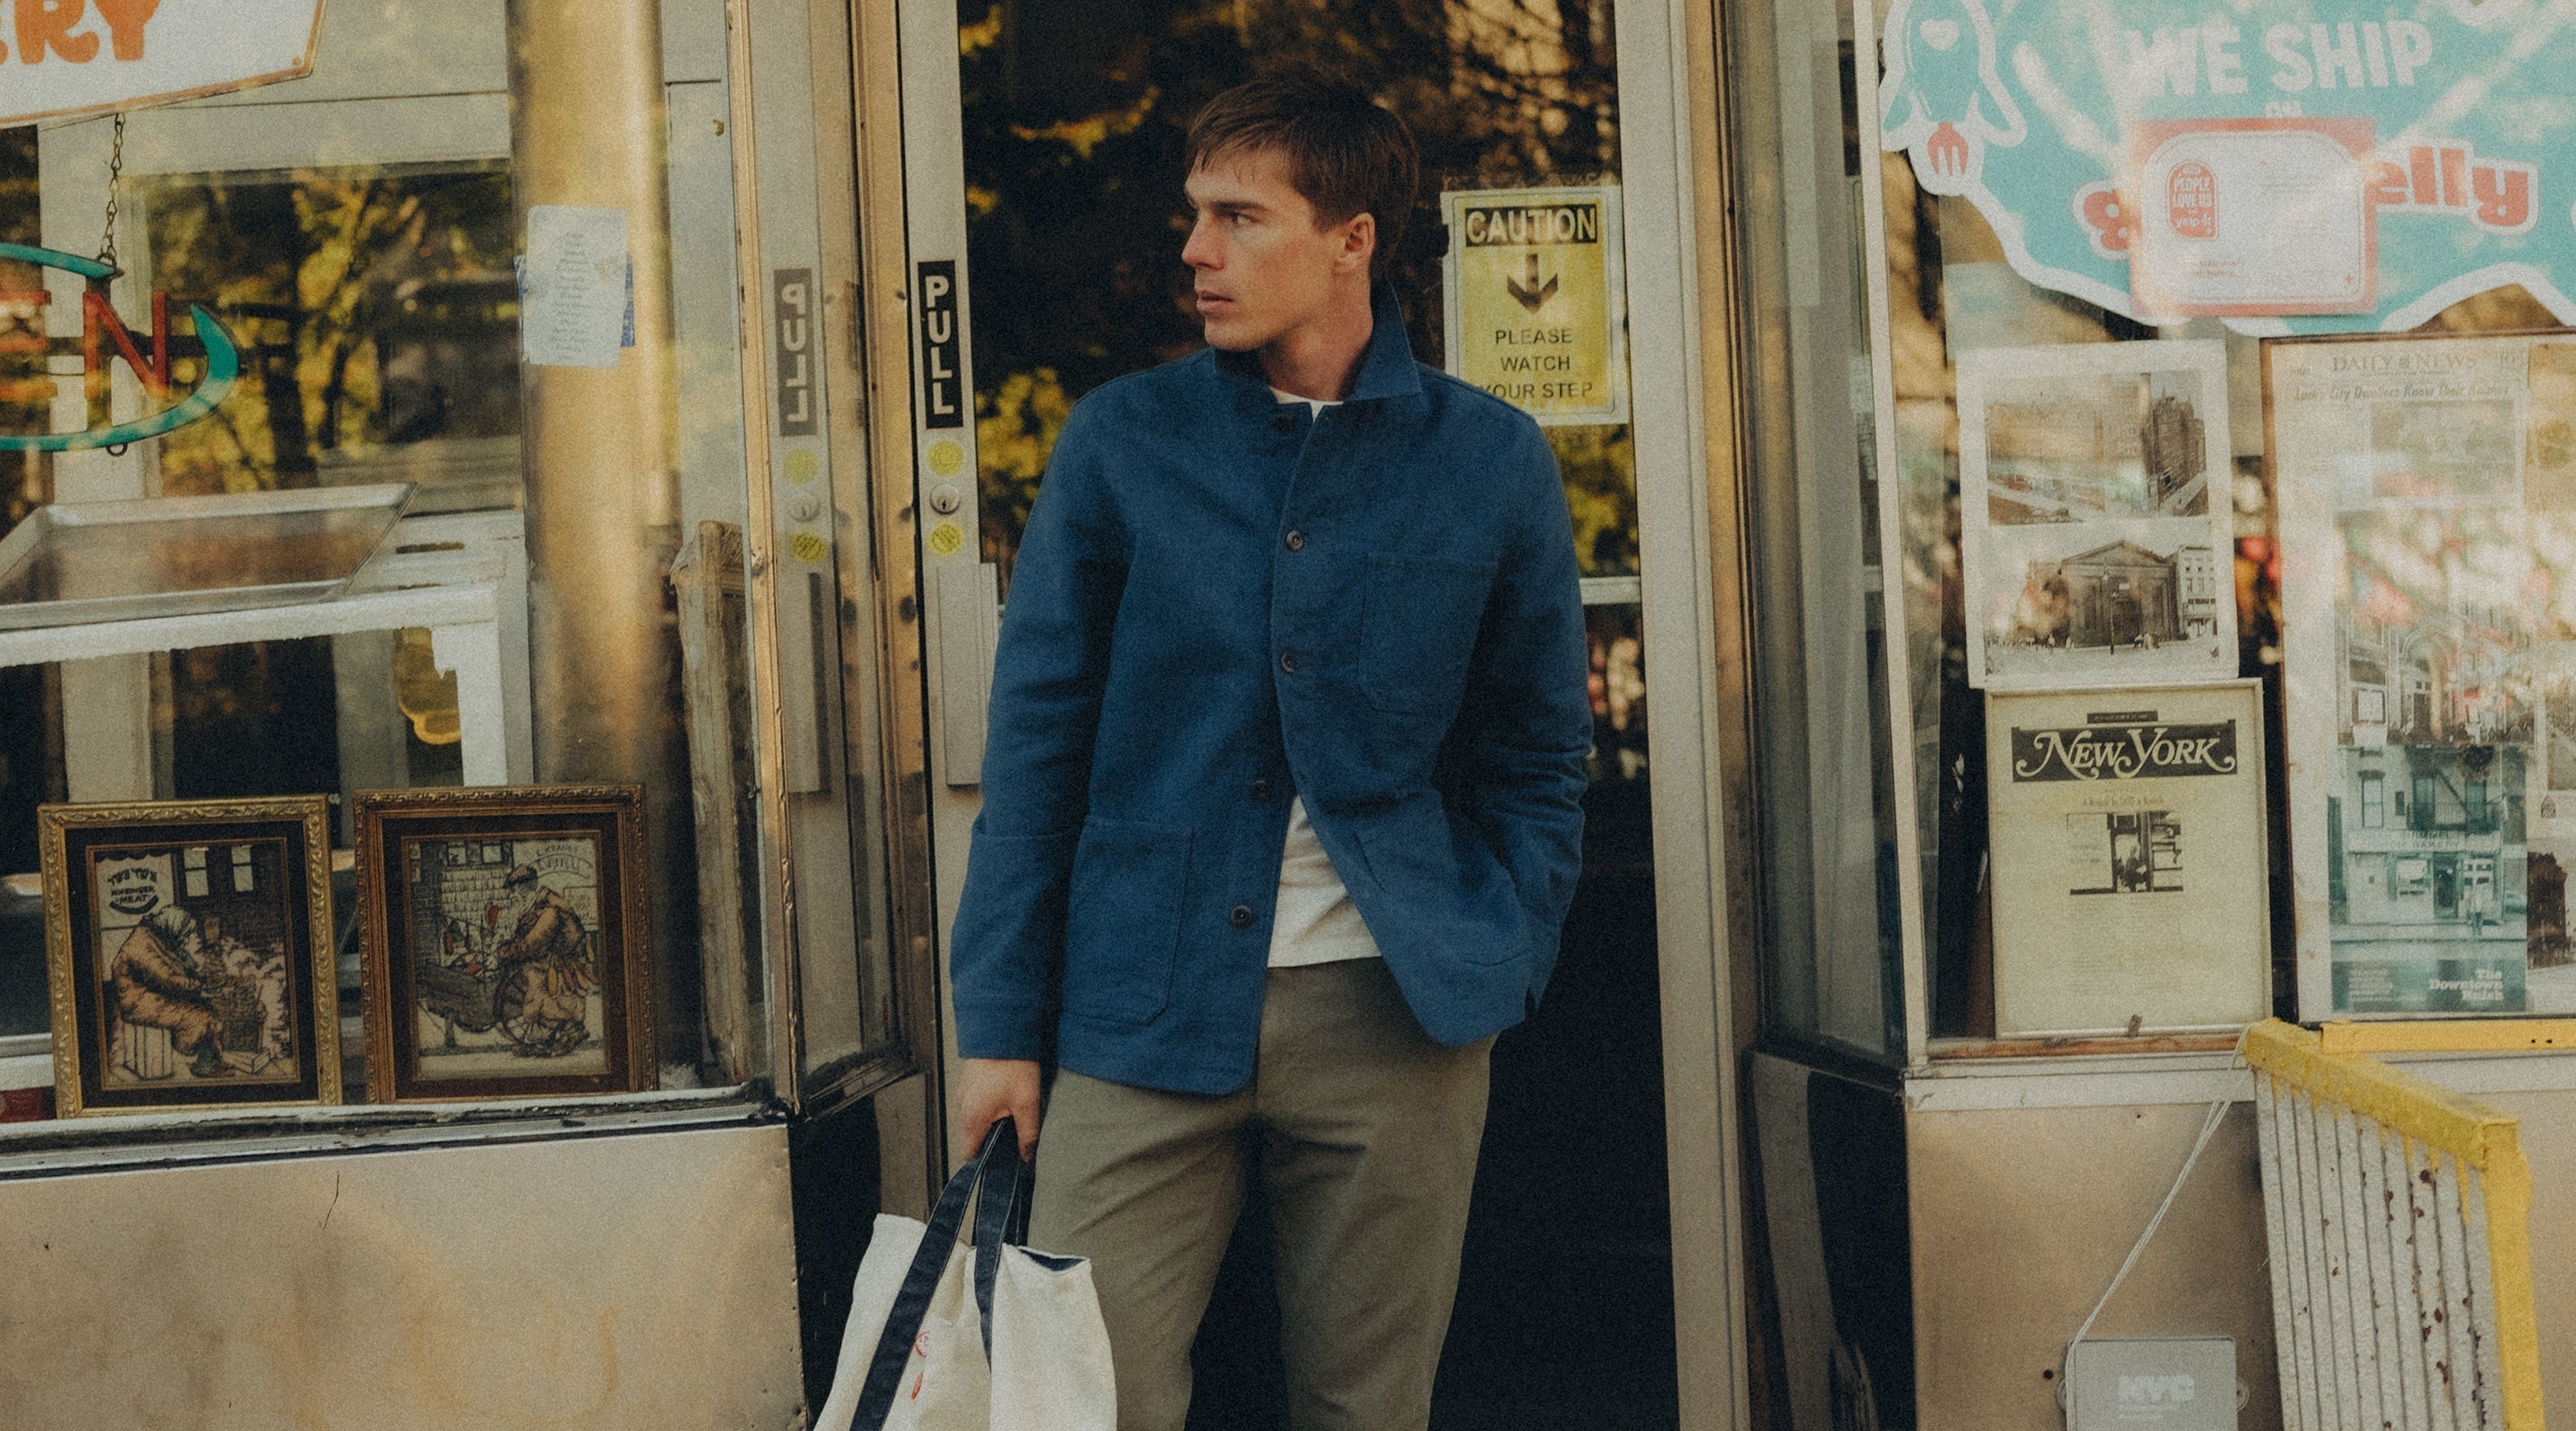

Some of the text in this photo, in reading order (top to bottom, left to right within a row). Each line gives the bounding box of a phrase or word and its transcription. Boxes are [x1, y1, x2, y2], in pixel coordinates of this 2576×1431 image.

[0, 0, 162, 65] RY
[2124, 21, 2433, 97] WE SHIP
[1466, 207, 1597, 244] CAUTION
[925, 275, 954, 416] PULL
[1495, 328, 1573, 345] PLEASE
[1500, 356, 1571, 372] WATCH
[2333, 352, 2478, 371] DAILY NEWS
[1542, 381, 1592, 399] STEP
[2403, 381, 2434, 397] Know
[2114, 727, 2235, 779] YORK
